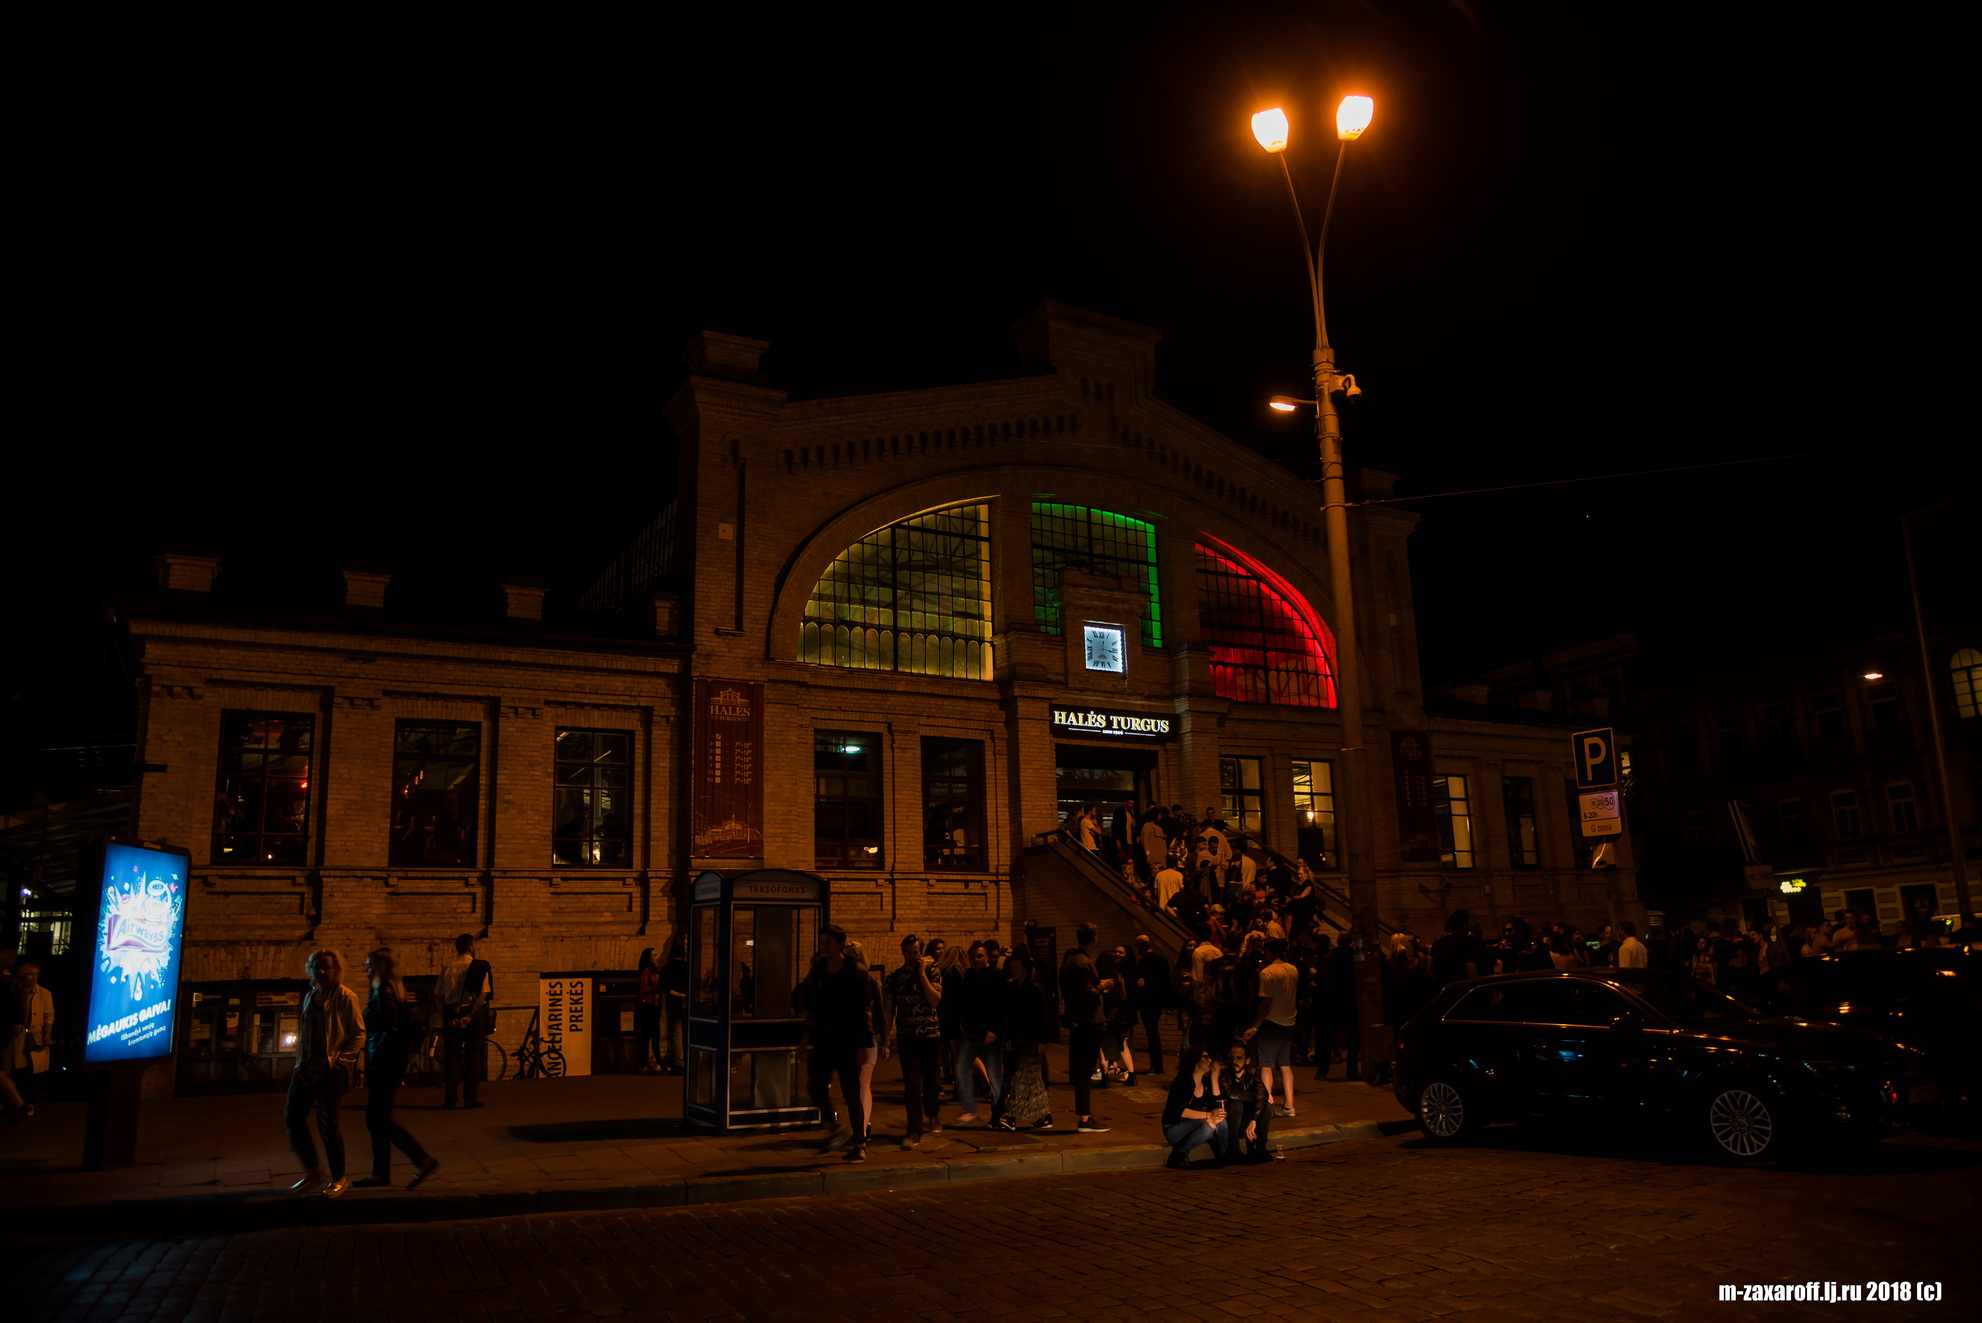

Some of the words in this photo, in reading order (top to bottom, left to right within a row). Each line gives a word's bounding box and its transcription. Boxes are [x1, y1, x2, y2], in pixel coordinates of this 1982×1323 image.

[1053, 710, 1107, 728] HALĖS
[1110, 715, 1170, 733] TURGUS
[1583, 736, 1607, 781] P
[1605, 797, 1614, 806] 50
[1591, 824, 1596, 833] G
[749, 885, 806, 895] TAKSOFONAS
[566, 980, 584, 1032] PREKĖS
[87, 1012, 138, 1045] MĖGAUKIS
[138, 998, 171, 1022] GAIVA!
